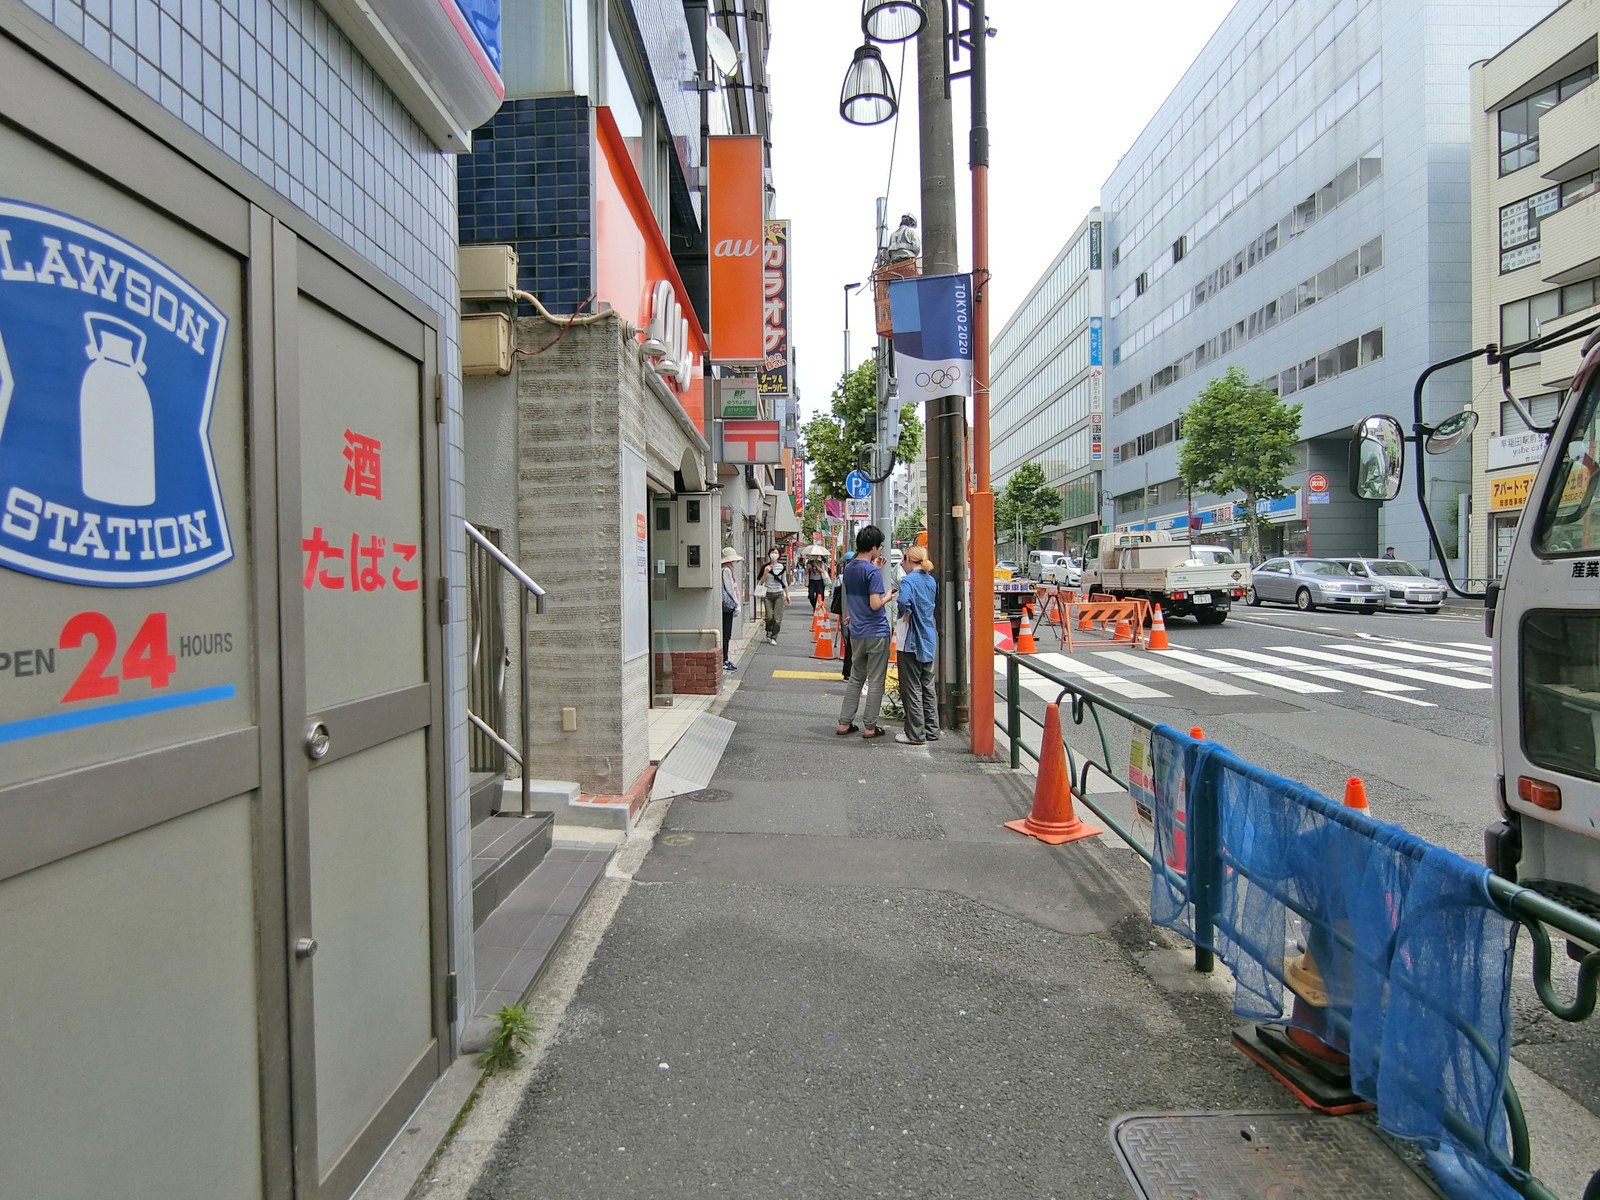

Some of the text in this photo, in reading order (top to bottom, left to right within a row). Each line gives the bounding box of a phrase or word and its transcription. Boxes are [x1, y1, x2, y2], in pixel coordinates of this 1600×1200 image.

[714, 237, 759, 257] au
[0, 229, 210, 356] LAWSON
[954, 283, 968, 355] TOKYO 2020
[342, 428, 382, 501] 酒
[852, 478, 862, 496] P
[859, 488, 866, 496] 60
[1494, 479, 1533, 498] アパート・マ
[2, 486, 212, 560] STATION
[302, 527, 418, 592] たばこ
[1571, 560, 1599, 578] 産業
[59, 611, 176, 704] 24
[180, 633, 233, 658] HOURS
